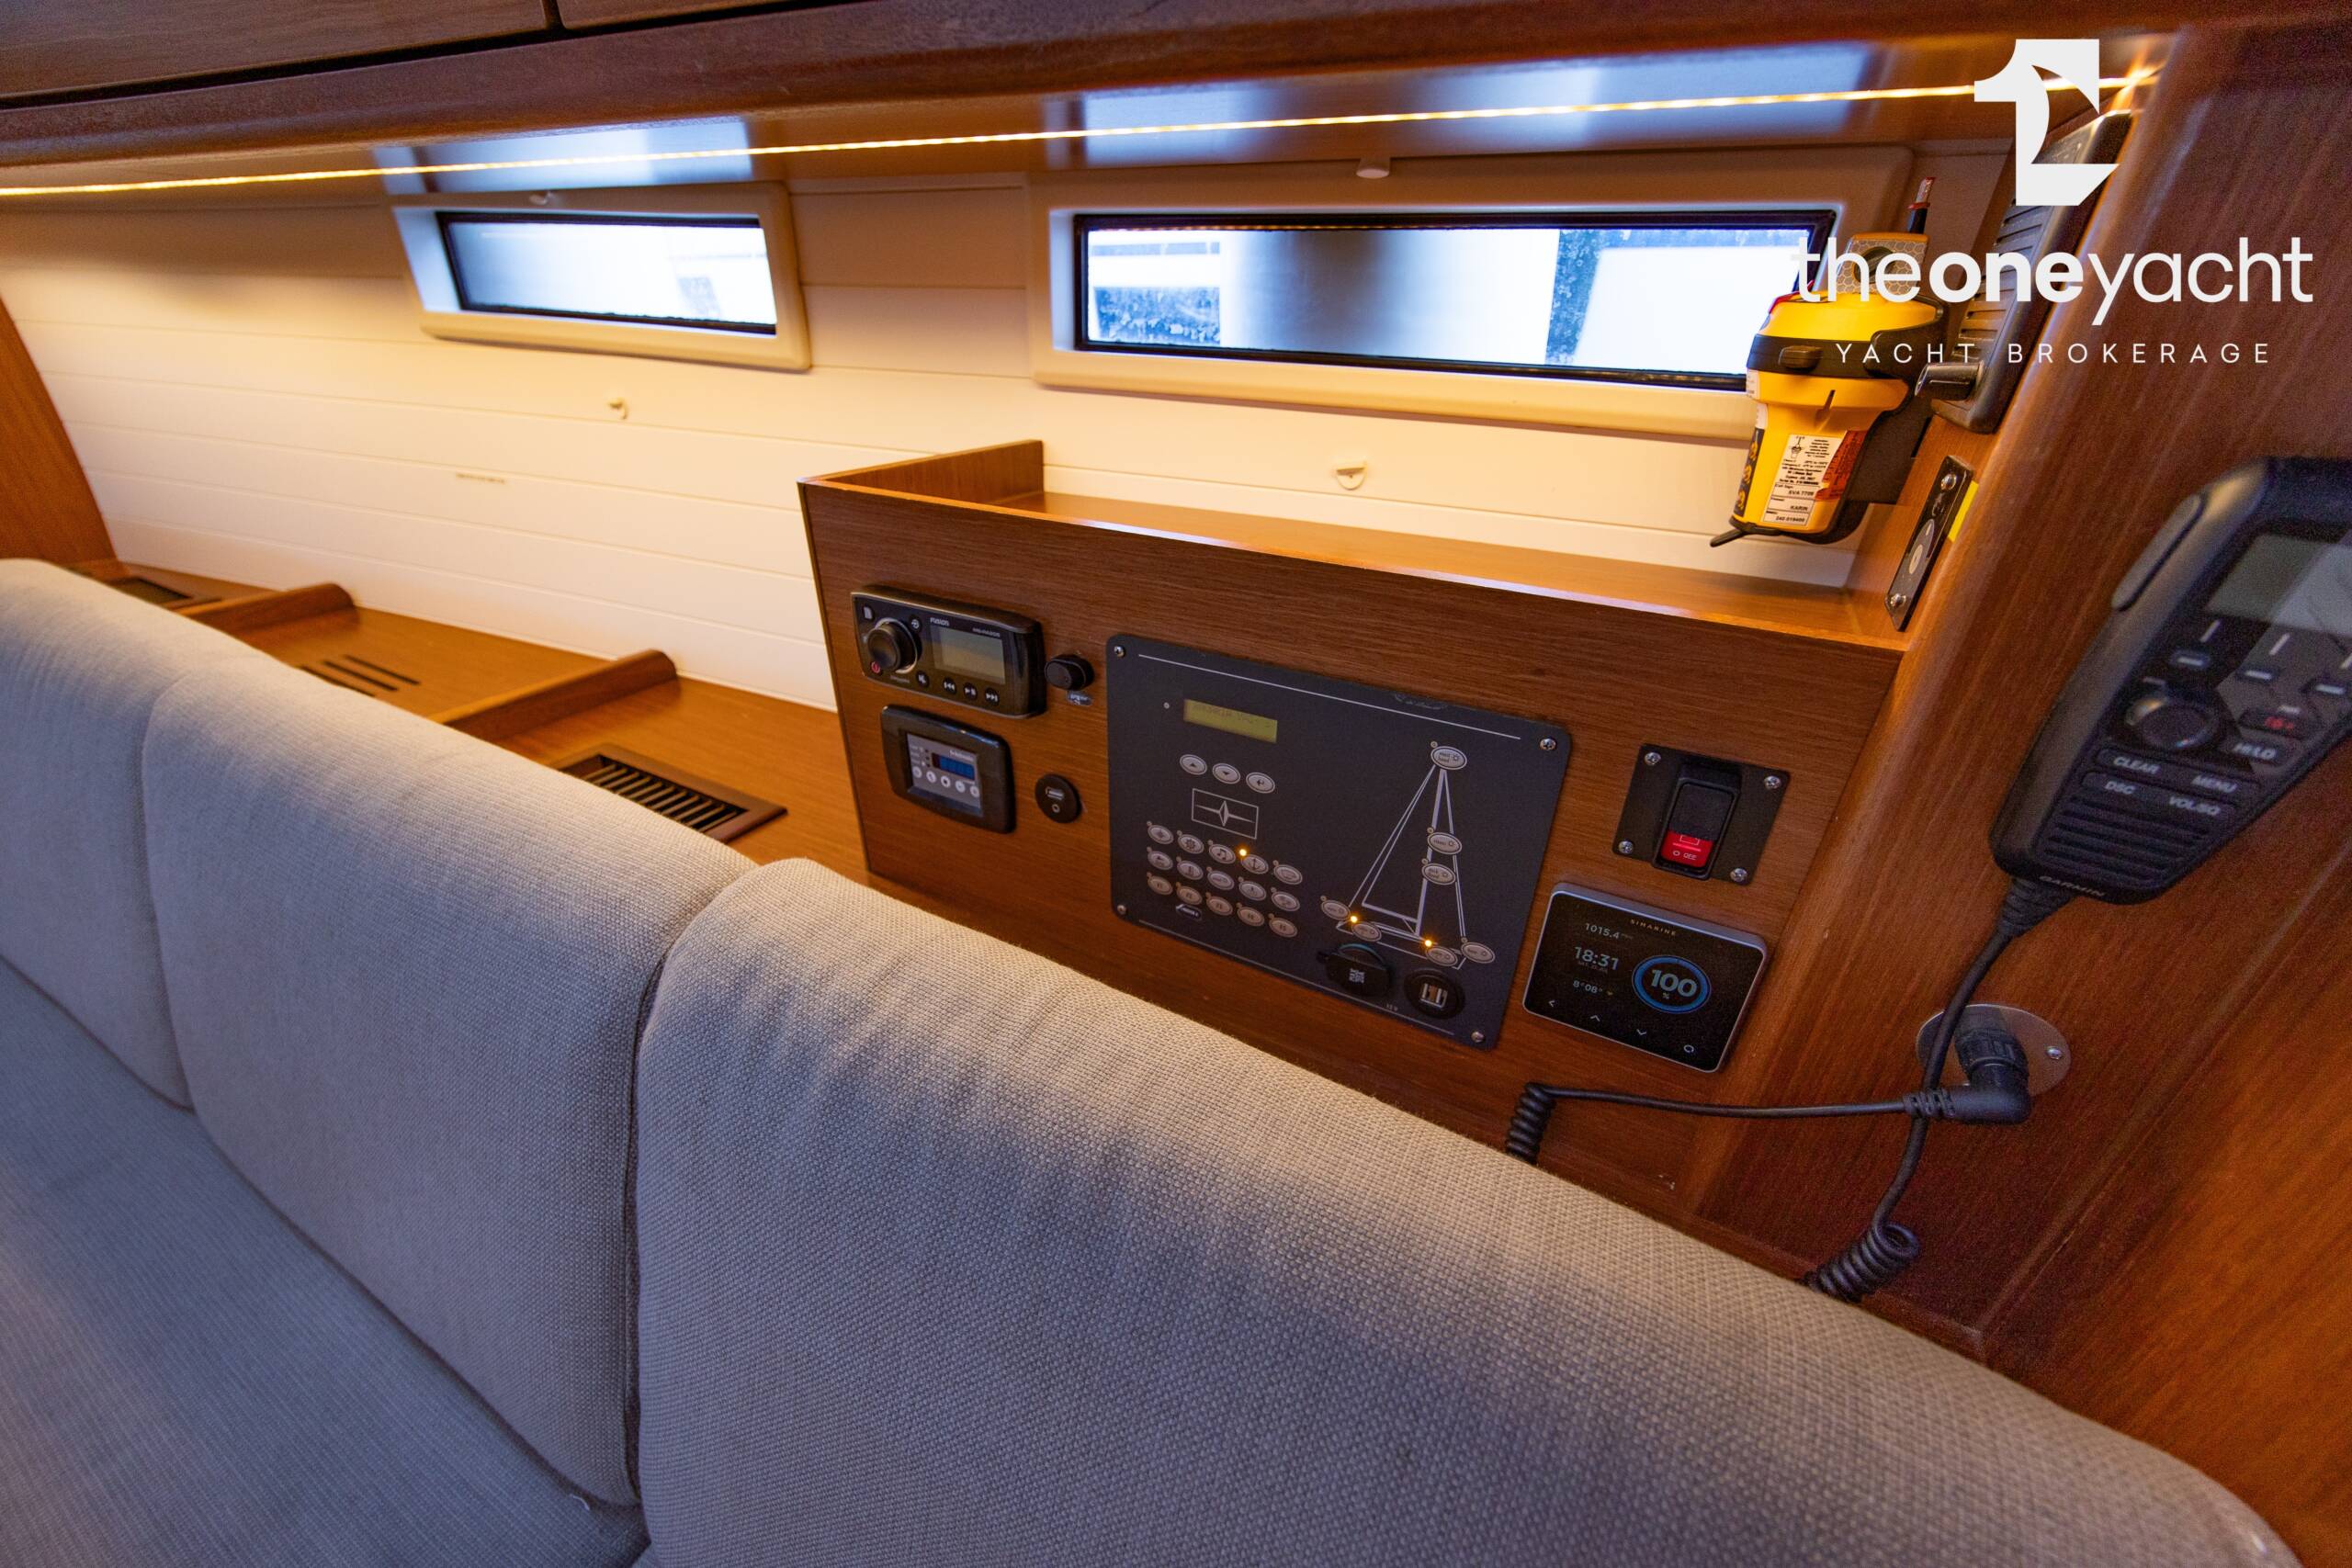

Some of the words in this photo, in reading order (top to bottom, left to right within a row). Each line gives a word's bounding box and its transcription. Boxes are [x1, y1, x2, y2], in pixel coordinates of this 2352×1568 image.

[2113, 755, 2160, 775] CLEAR
[2104, 780, 2136, 795] DSC
[2191, 773, 2238, 794] MENU
[1574, 946, 1620, 971] 18:31
[1651, 969, 1698, 998] 100
